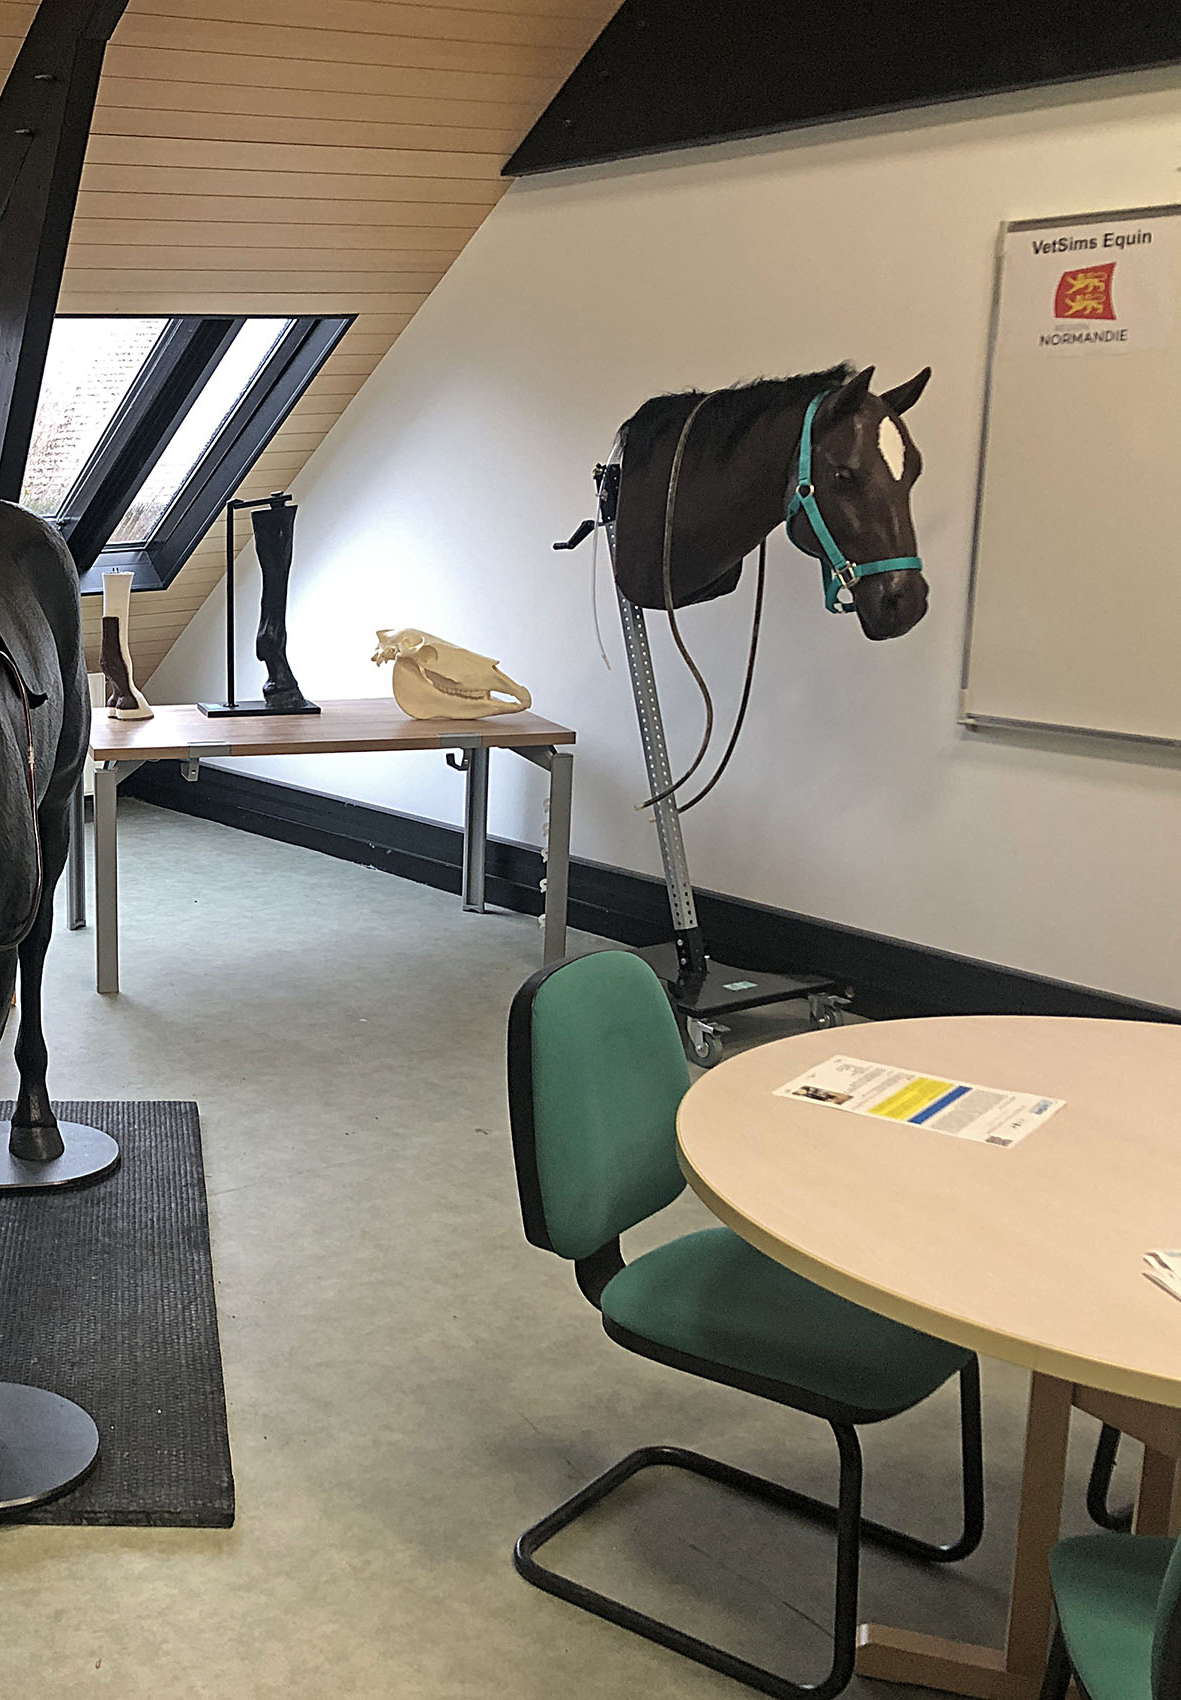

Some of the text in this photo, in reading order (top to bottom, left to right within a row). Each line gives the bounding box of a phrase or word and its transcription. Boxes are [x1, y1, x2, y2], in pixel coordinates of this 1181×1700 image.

[1033, 230, 1152, 255] VetSims Equin
[1039, 330, 1127, 345] NORMANDIE
